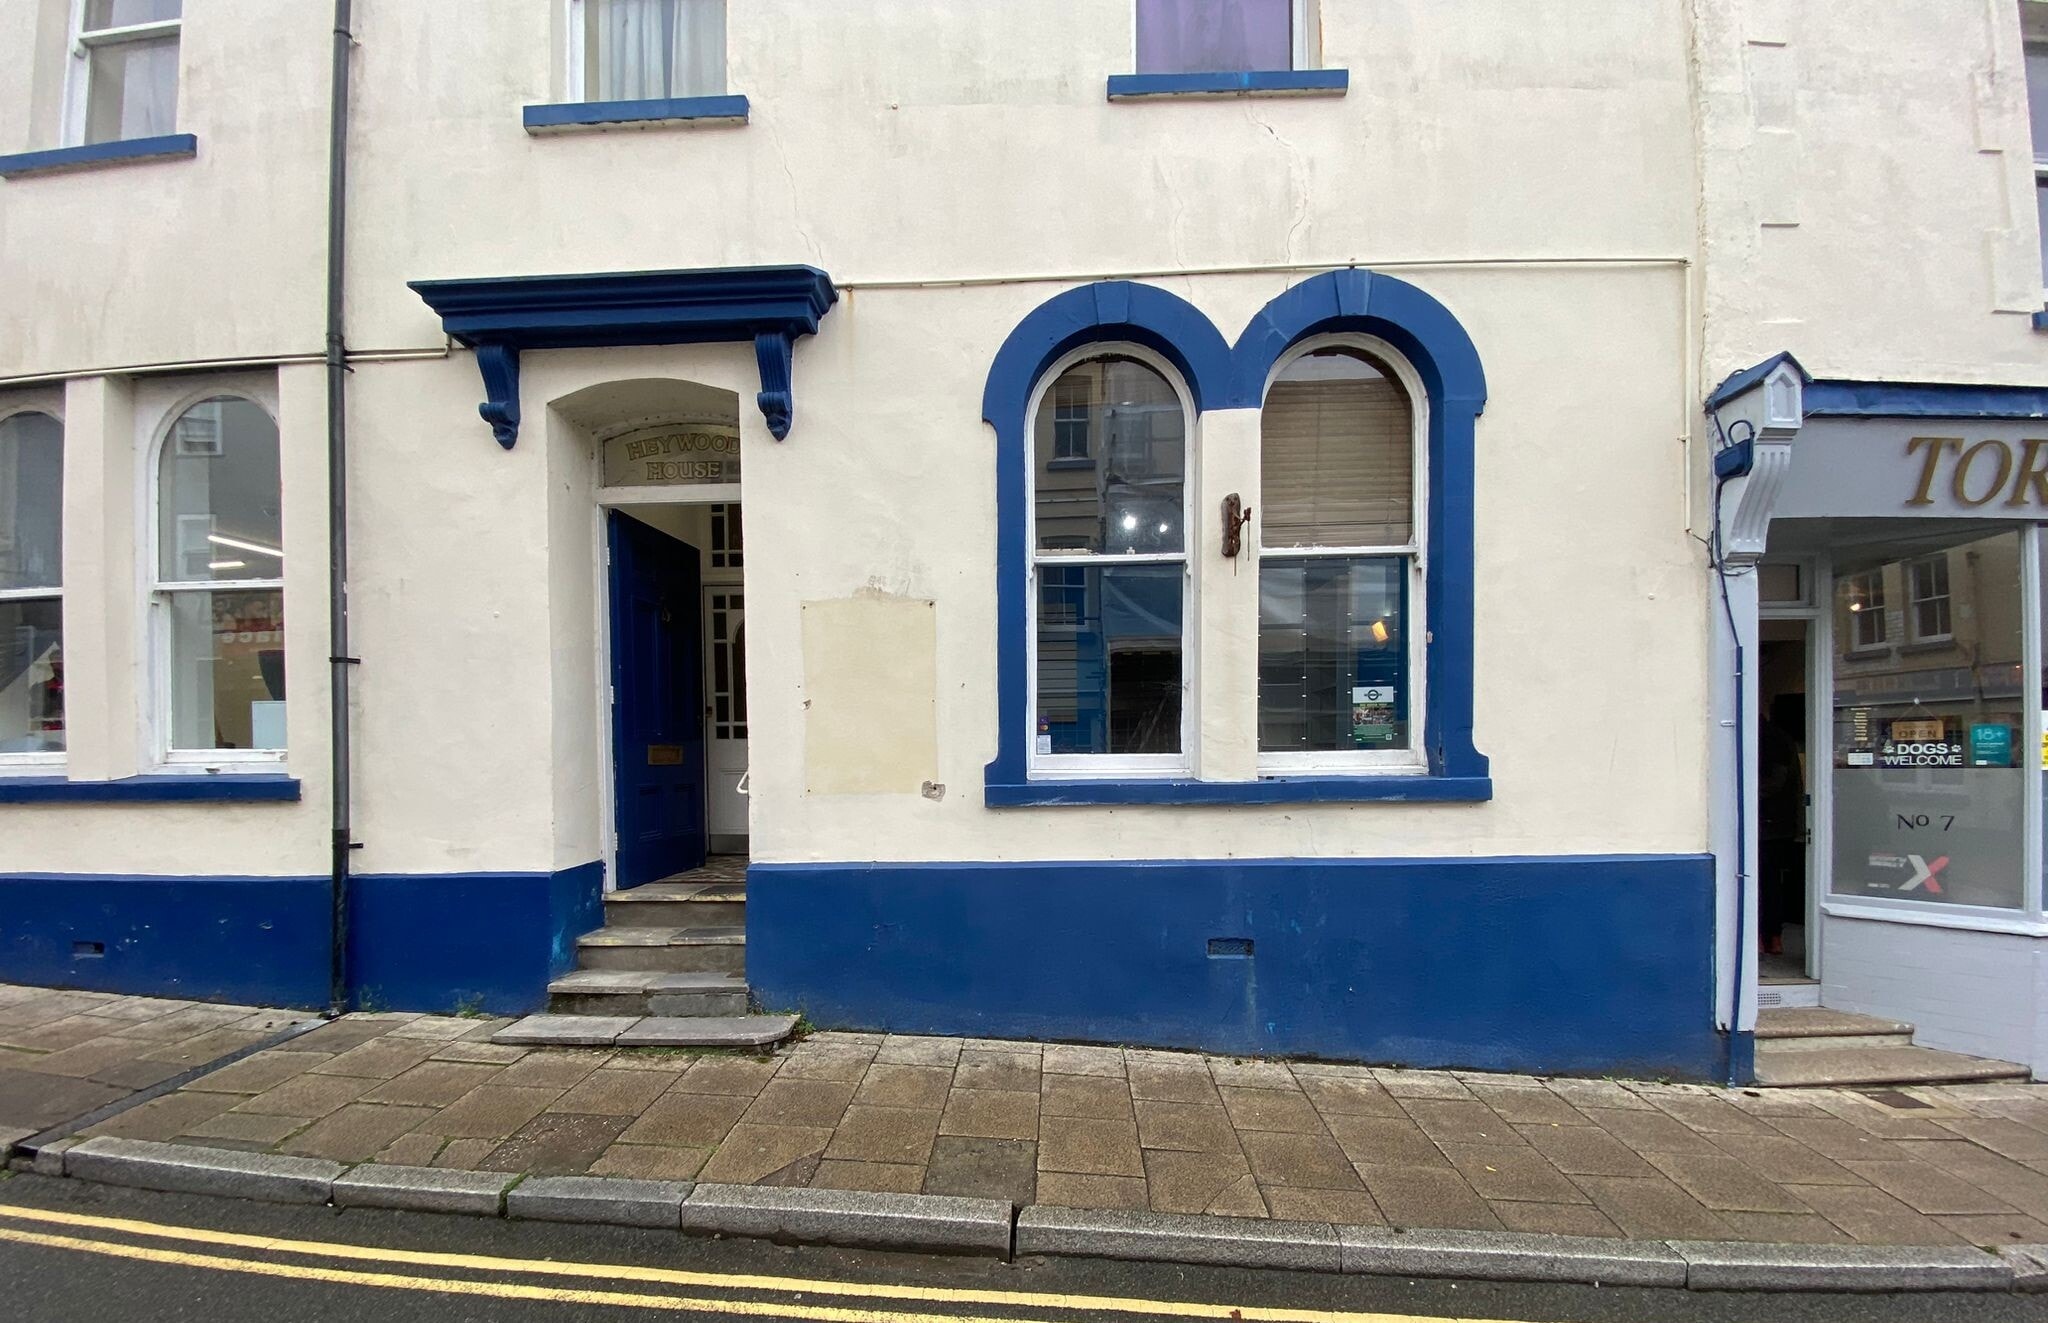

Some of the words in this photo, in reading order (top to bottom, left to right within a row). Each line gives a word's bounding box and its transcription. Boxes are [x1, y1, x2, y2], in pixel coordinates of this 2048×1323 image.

[626, 433, 740, 461] HEYWOOD
[646, 461, 721, 480] HOUSE
[1898, 729, 1937, 738] OPEN
[1975, 728, 2006, 741] 18+
[1897, 743, 1948, 755] DOGS
[1884, 755, 1963, 766] WELCOME
[1940, 814, 1955, 832] 7
